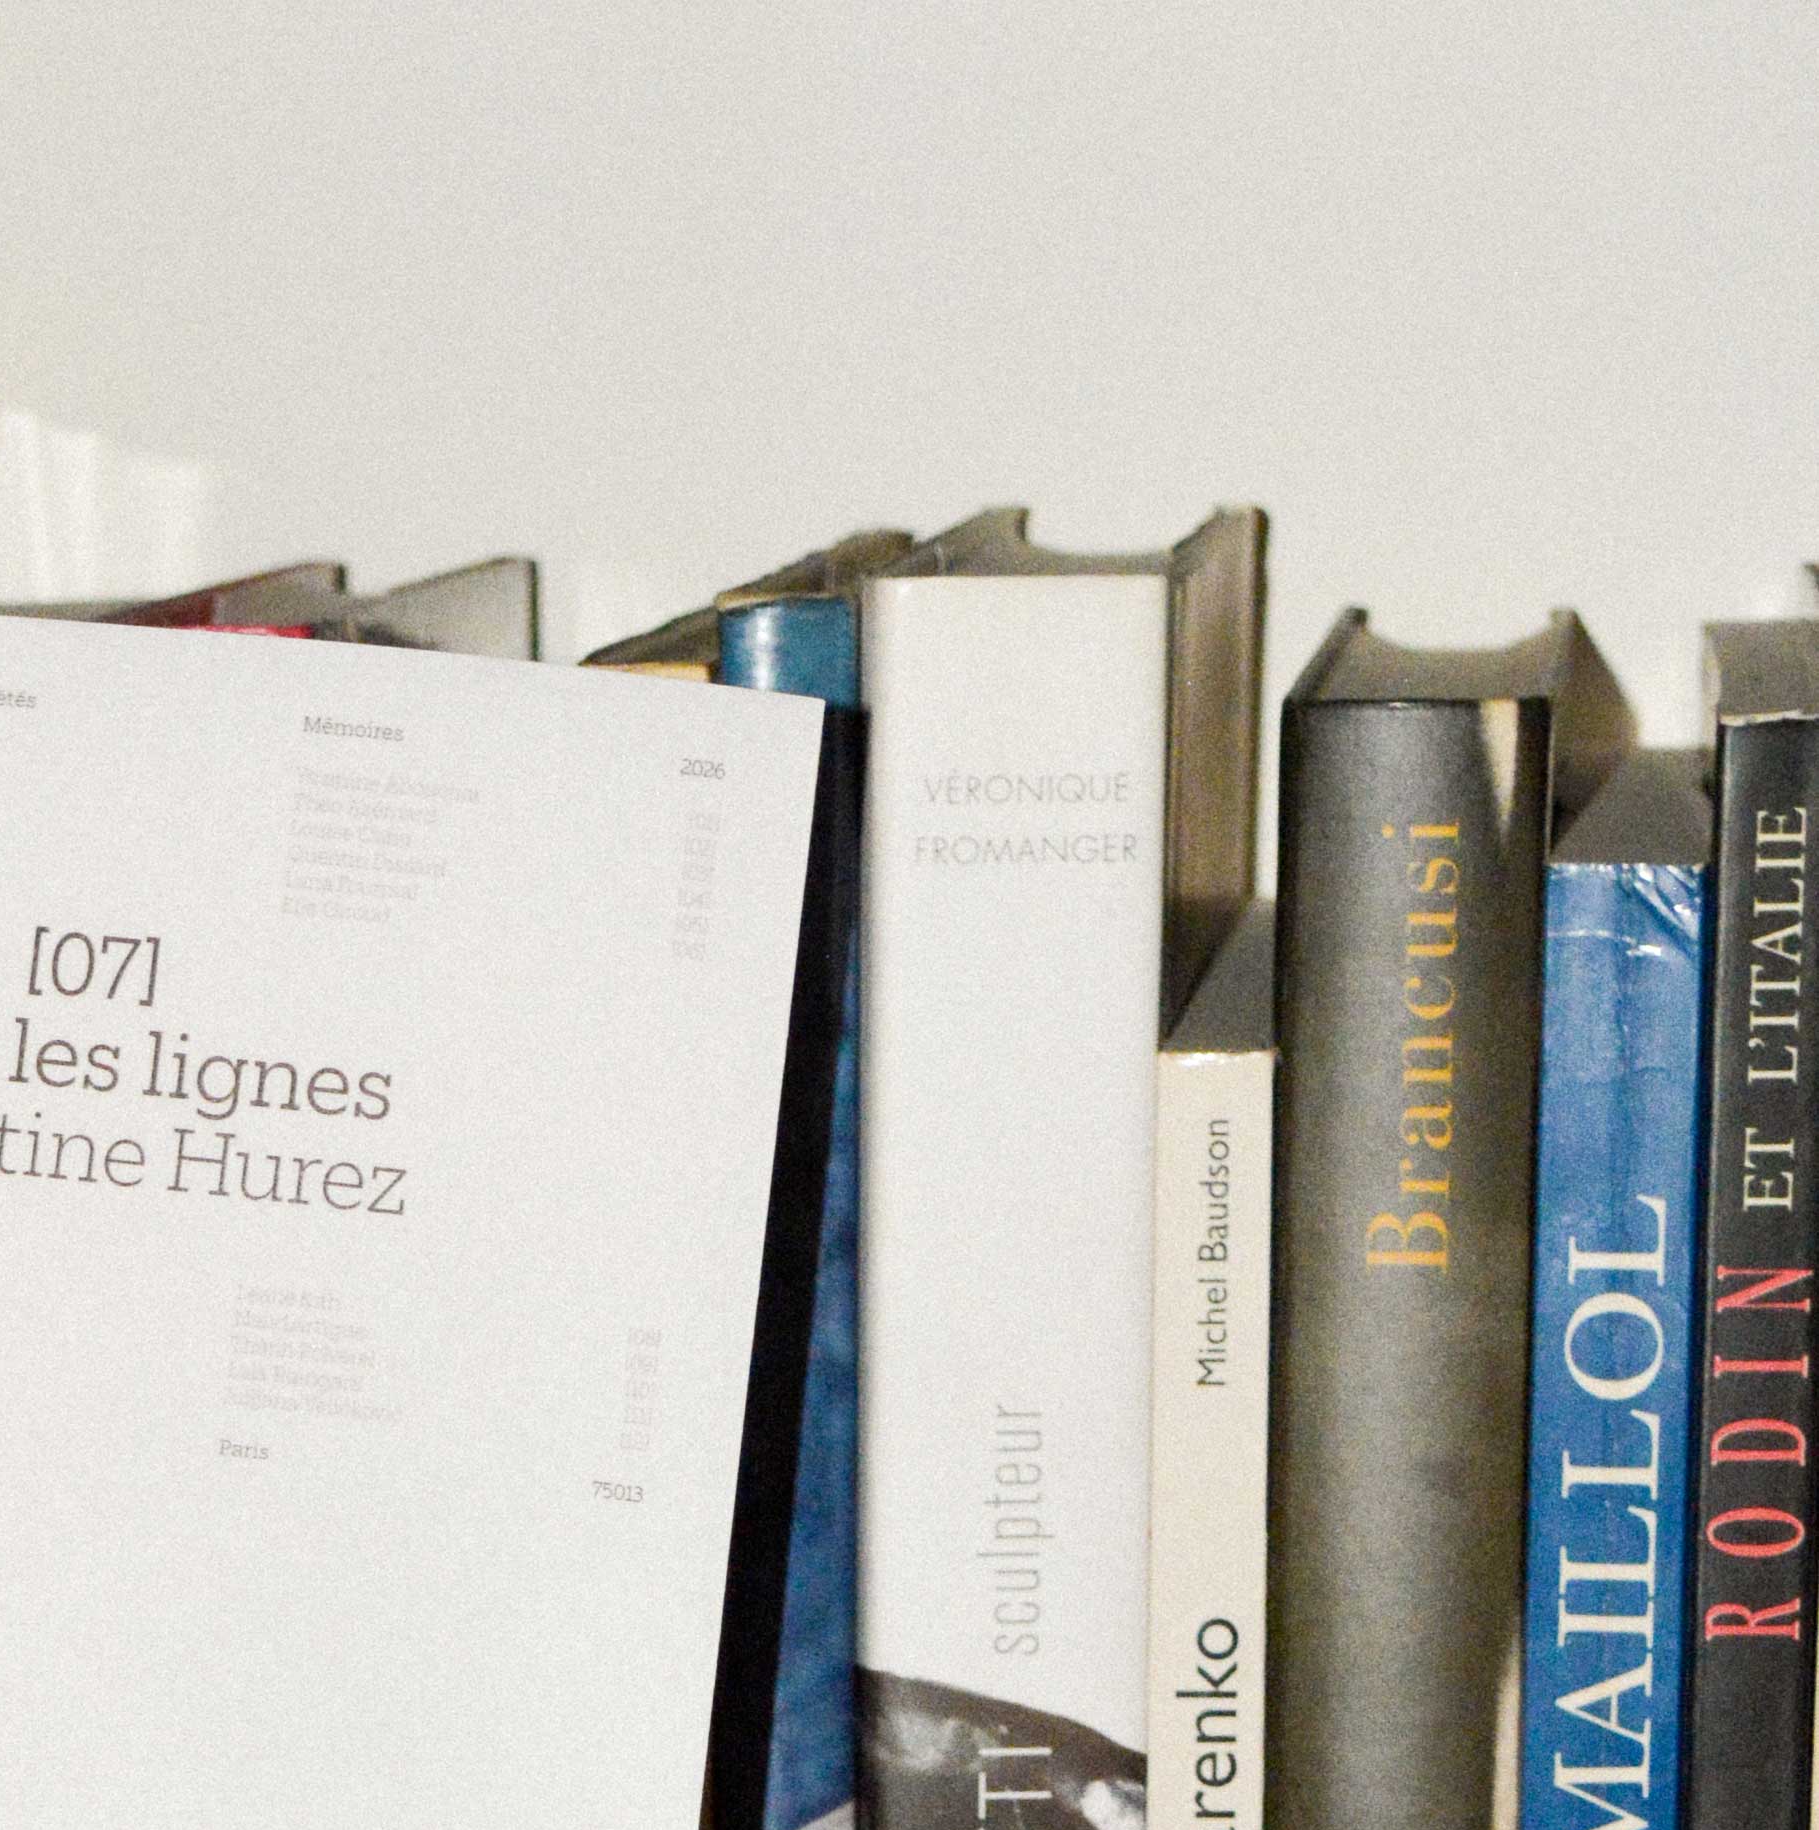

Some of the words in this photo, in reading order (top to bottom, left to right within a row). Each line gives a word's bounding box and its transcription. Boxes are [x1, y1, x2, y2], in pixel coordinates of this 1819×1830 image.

[302, 715, 405, 743] Mémoires
[679, 757, 727, 780] 2026
[924, 768, 1130, 805] VÉRONIQUE
[914, 834, 1139, 866] FROMANGER
[27, 925, 162, 1007] [07]
[1747, 805, 1808, 1086] L'ITALIE
[8, 1017, 122, 1091] les
[141, 1032, 394, 1121] lignes
[1367, 819, 1460, 1273] Brancusi
[166, 1127, 408, 1216] Hurez
[1197, 1117, 1231, 1263] Baudson
[1744, 1127, 1795, 1210] ET
[1196, 1275, 1229, 1388] Michel
[218, 1438, 269, 1461] Paris
[591, 1479, 645, 1505] 75013
[1704, 1265, 1813, 1642] RODIN
[976, 1401, 1055, 1656] sculpteur
